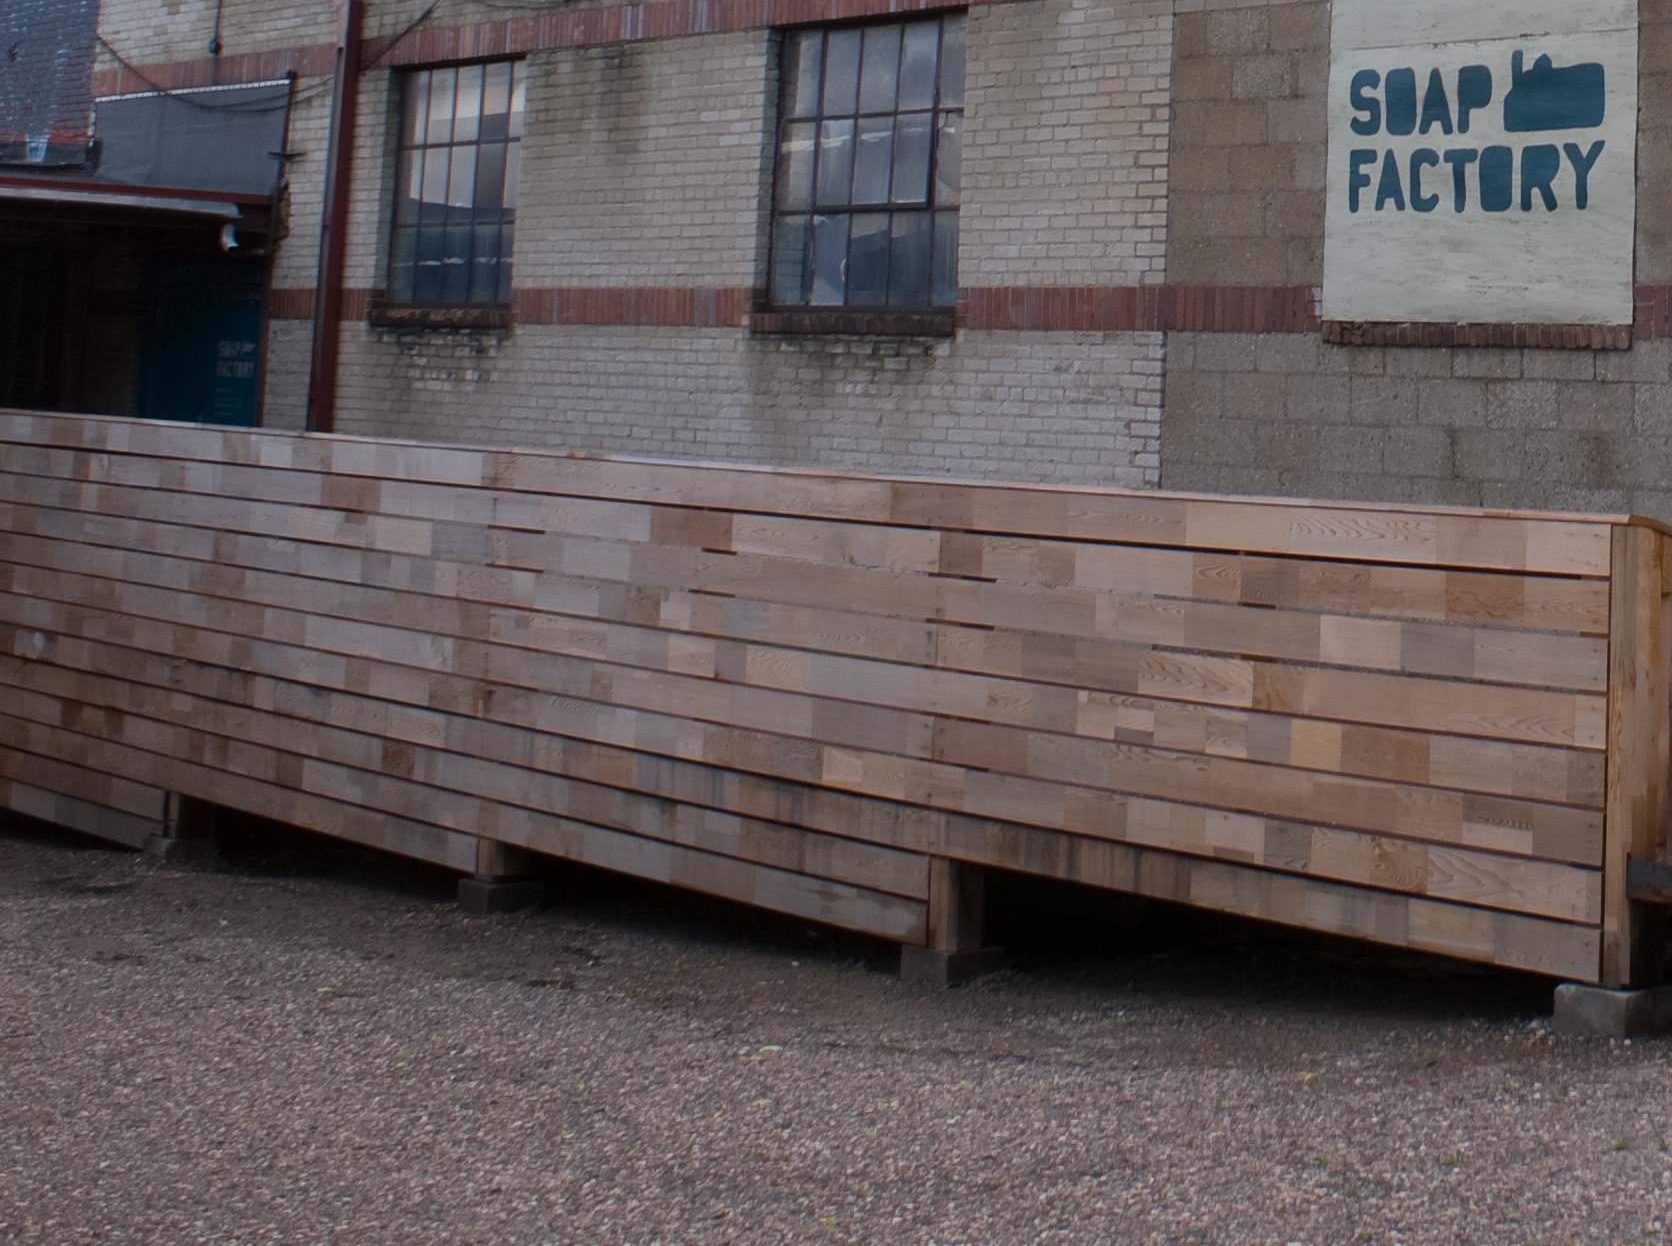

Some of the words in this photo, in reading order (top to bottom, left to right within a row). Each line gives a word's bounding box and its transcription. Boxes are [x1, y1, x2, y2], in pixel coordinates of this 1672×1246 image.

[1350, 65, 1492, 136] SOAP
[1348, 140, 1606, 213] FACTORY
[215, 359, 255, 378] FACTORY
